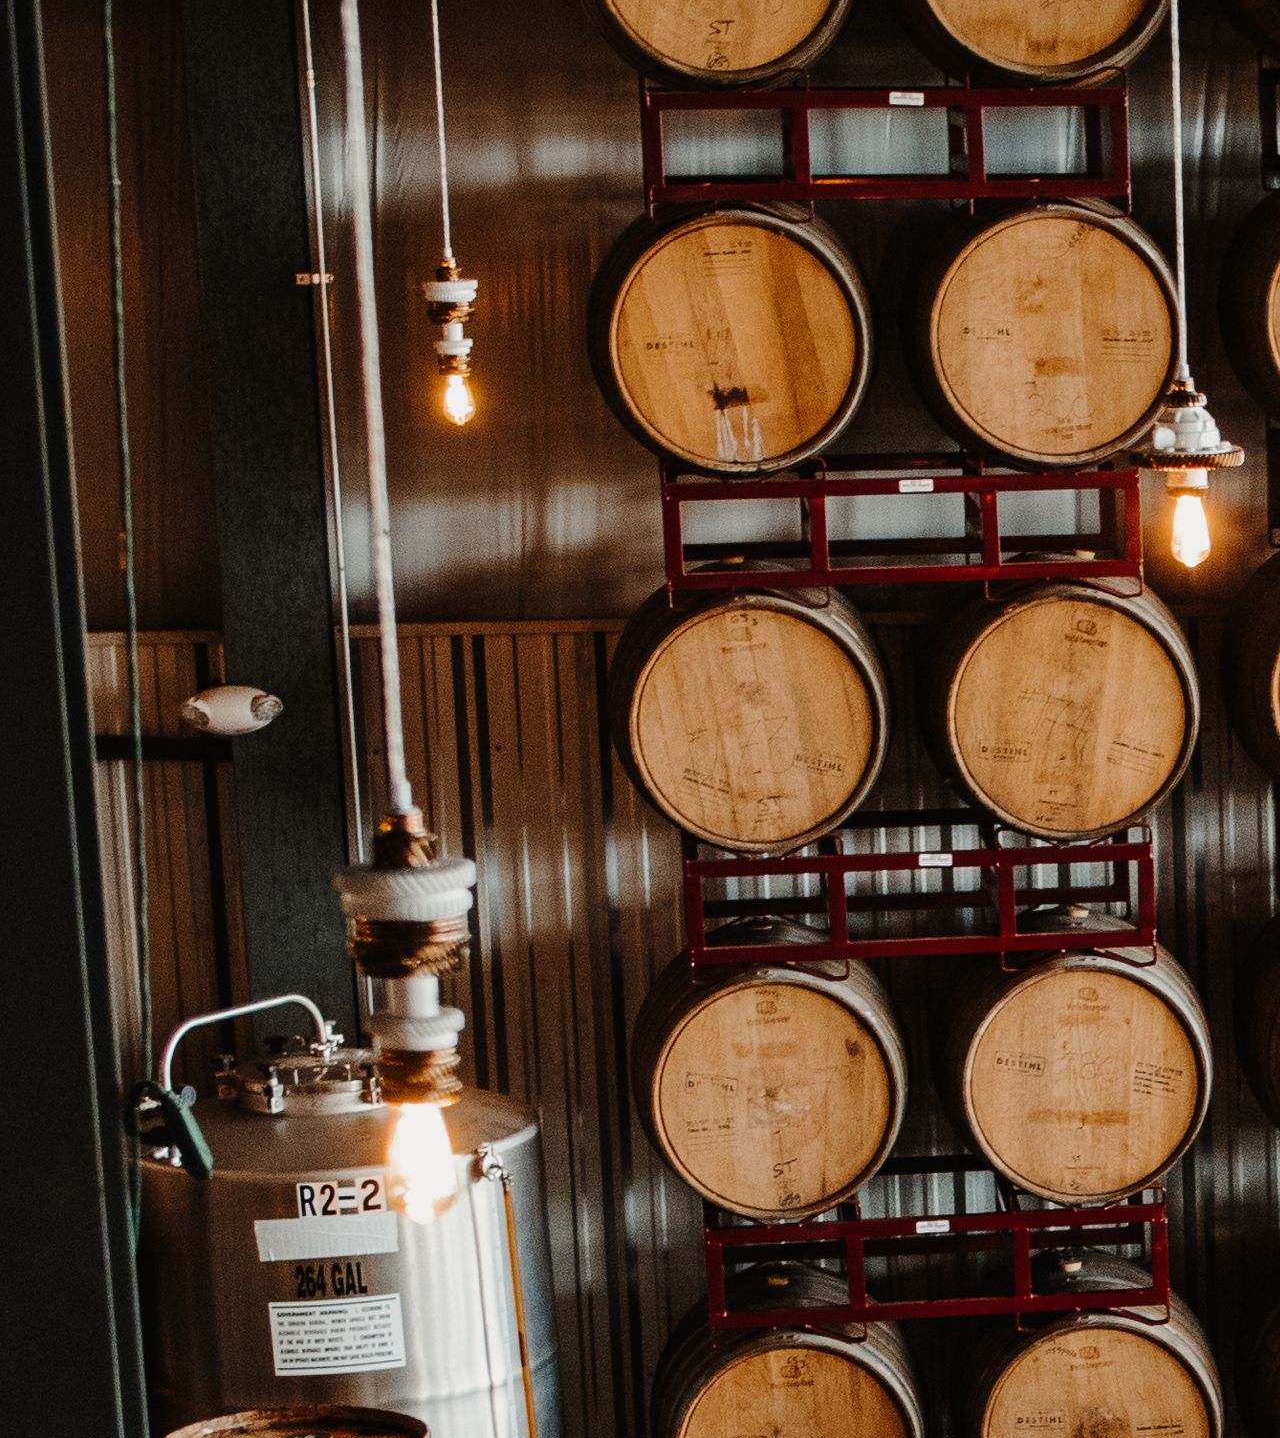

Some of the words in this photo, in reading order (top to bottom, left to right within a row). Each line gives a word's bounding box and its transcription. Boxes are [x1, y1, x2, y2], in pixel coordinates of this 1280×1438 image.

[995, 1056, 1043, 1071] DESTIHL
[299, 1179, 382, 1217] R2-2
[294, 1265, 327, 1299] 264
[331, 1261, 369, 1296] GAL
[1016, 1415, 1064, 1425] DESTIHL
